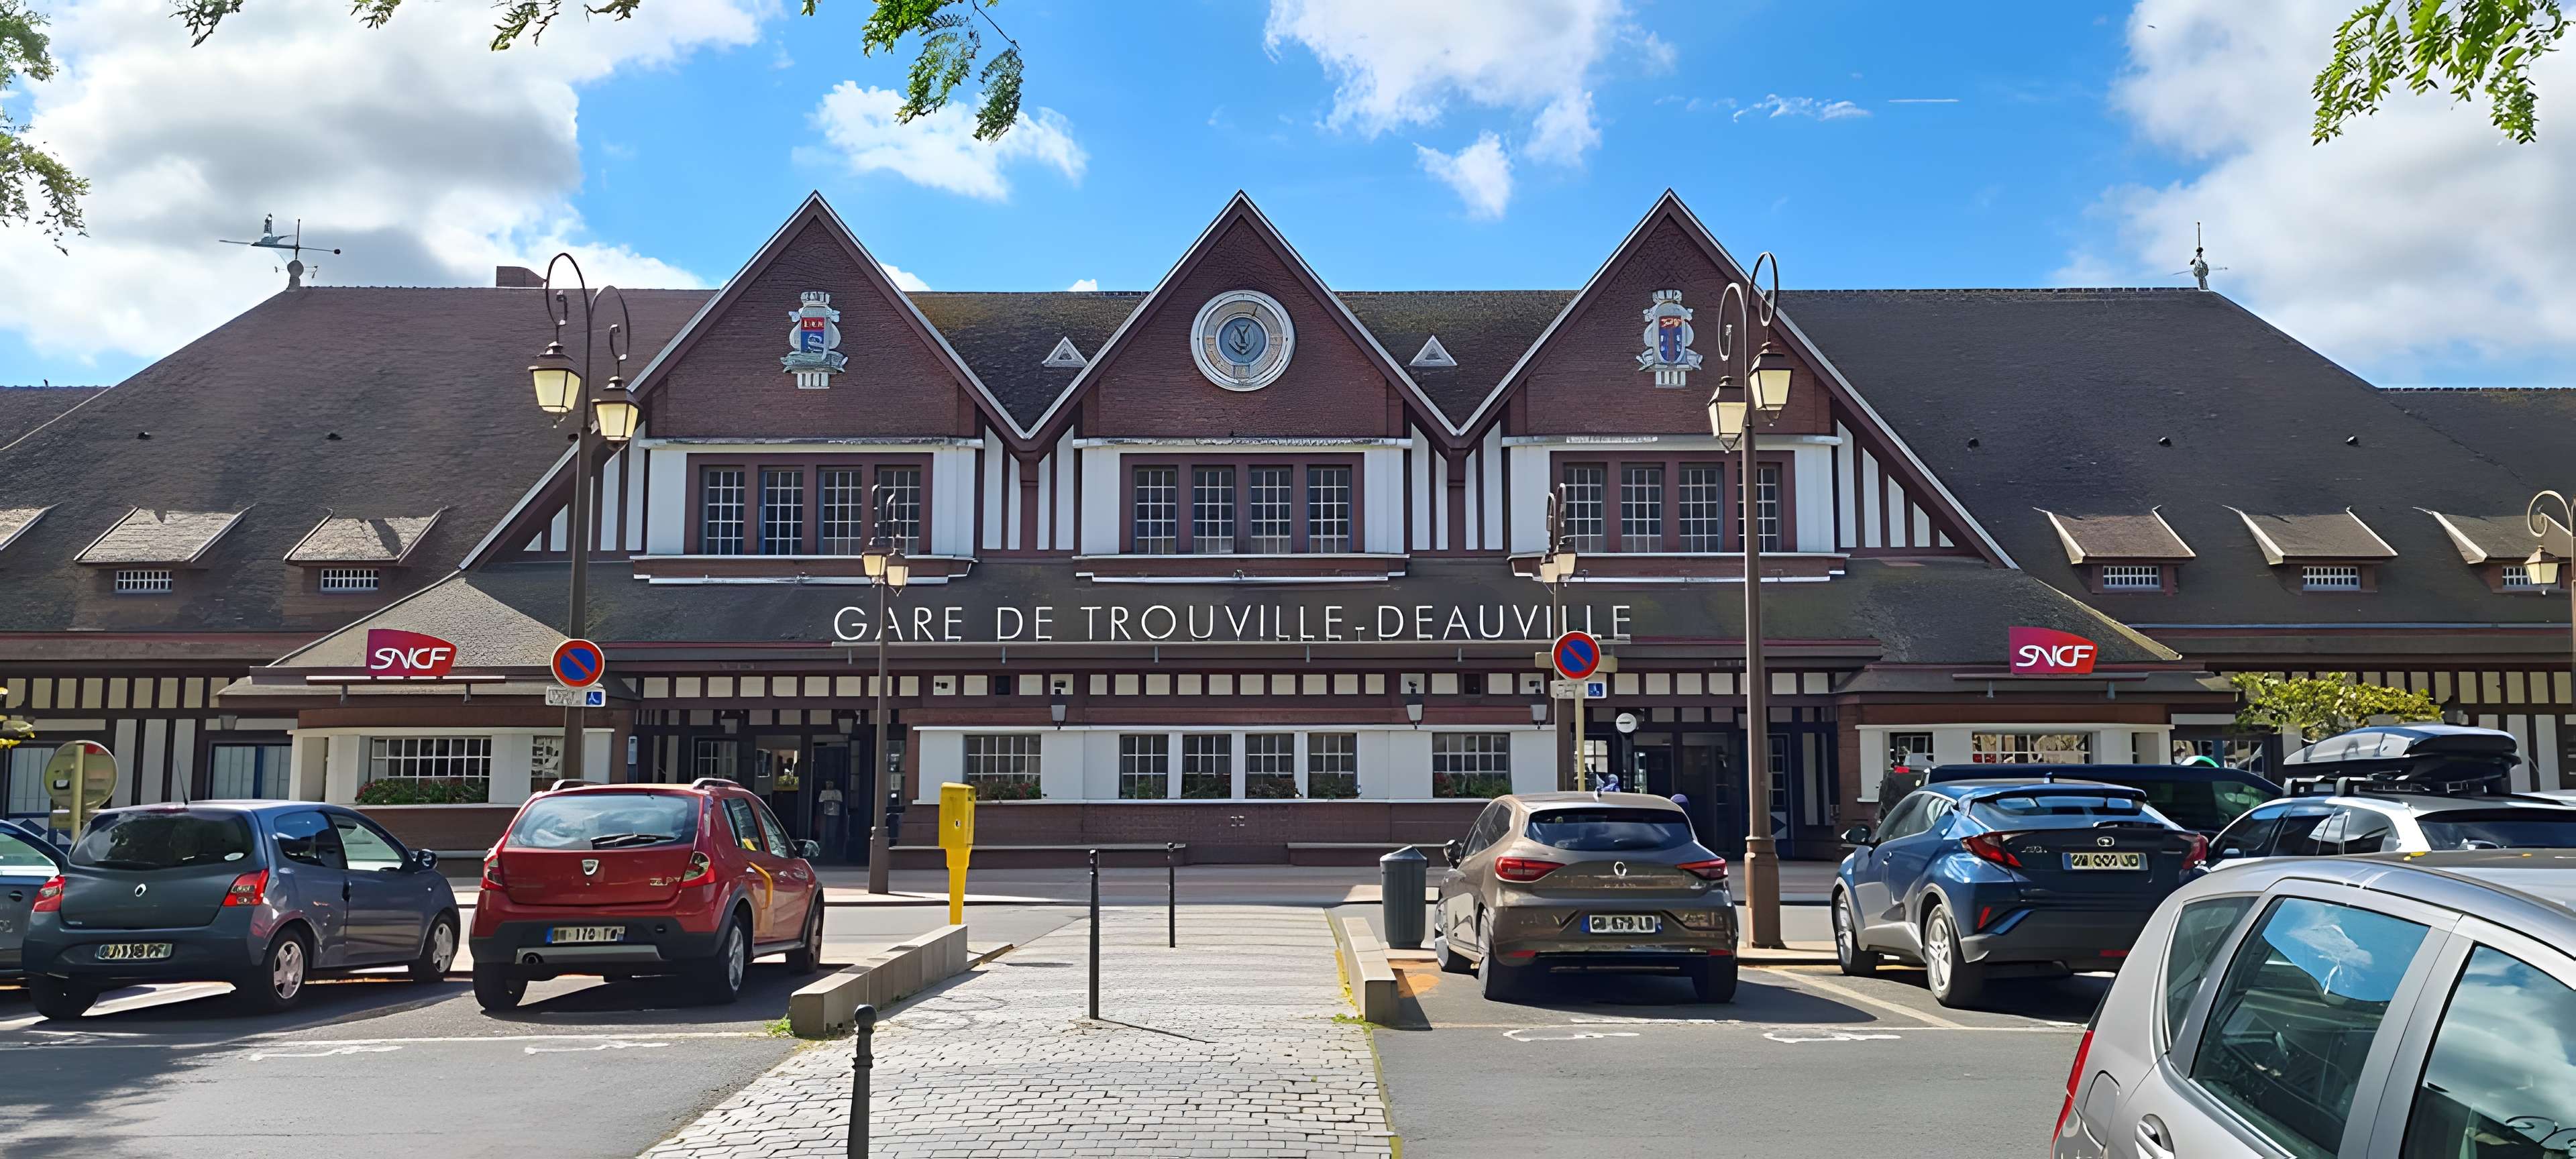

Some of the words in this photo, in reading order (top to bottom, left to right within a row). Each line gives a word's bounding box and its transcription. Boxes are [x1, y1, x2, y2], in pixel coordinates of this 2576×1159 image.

[833, 606, 963, 641] GARE
[996, 606, 1053, 641] DE
[370, 647, 451, 669] SNCF
[2015, 645, 2094, 667] SNCF
